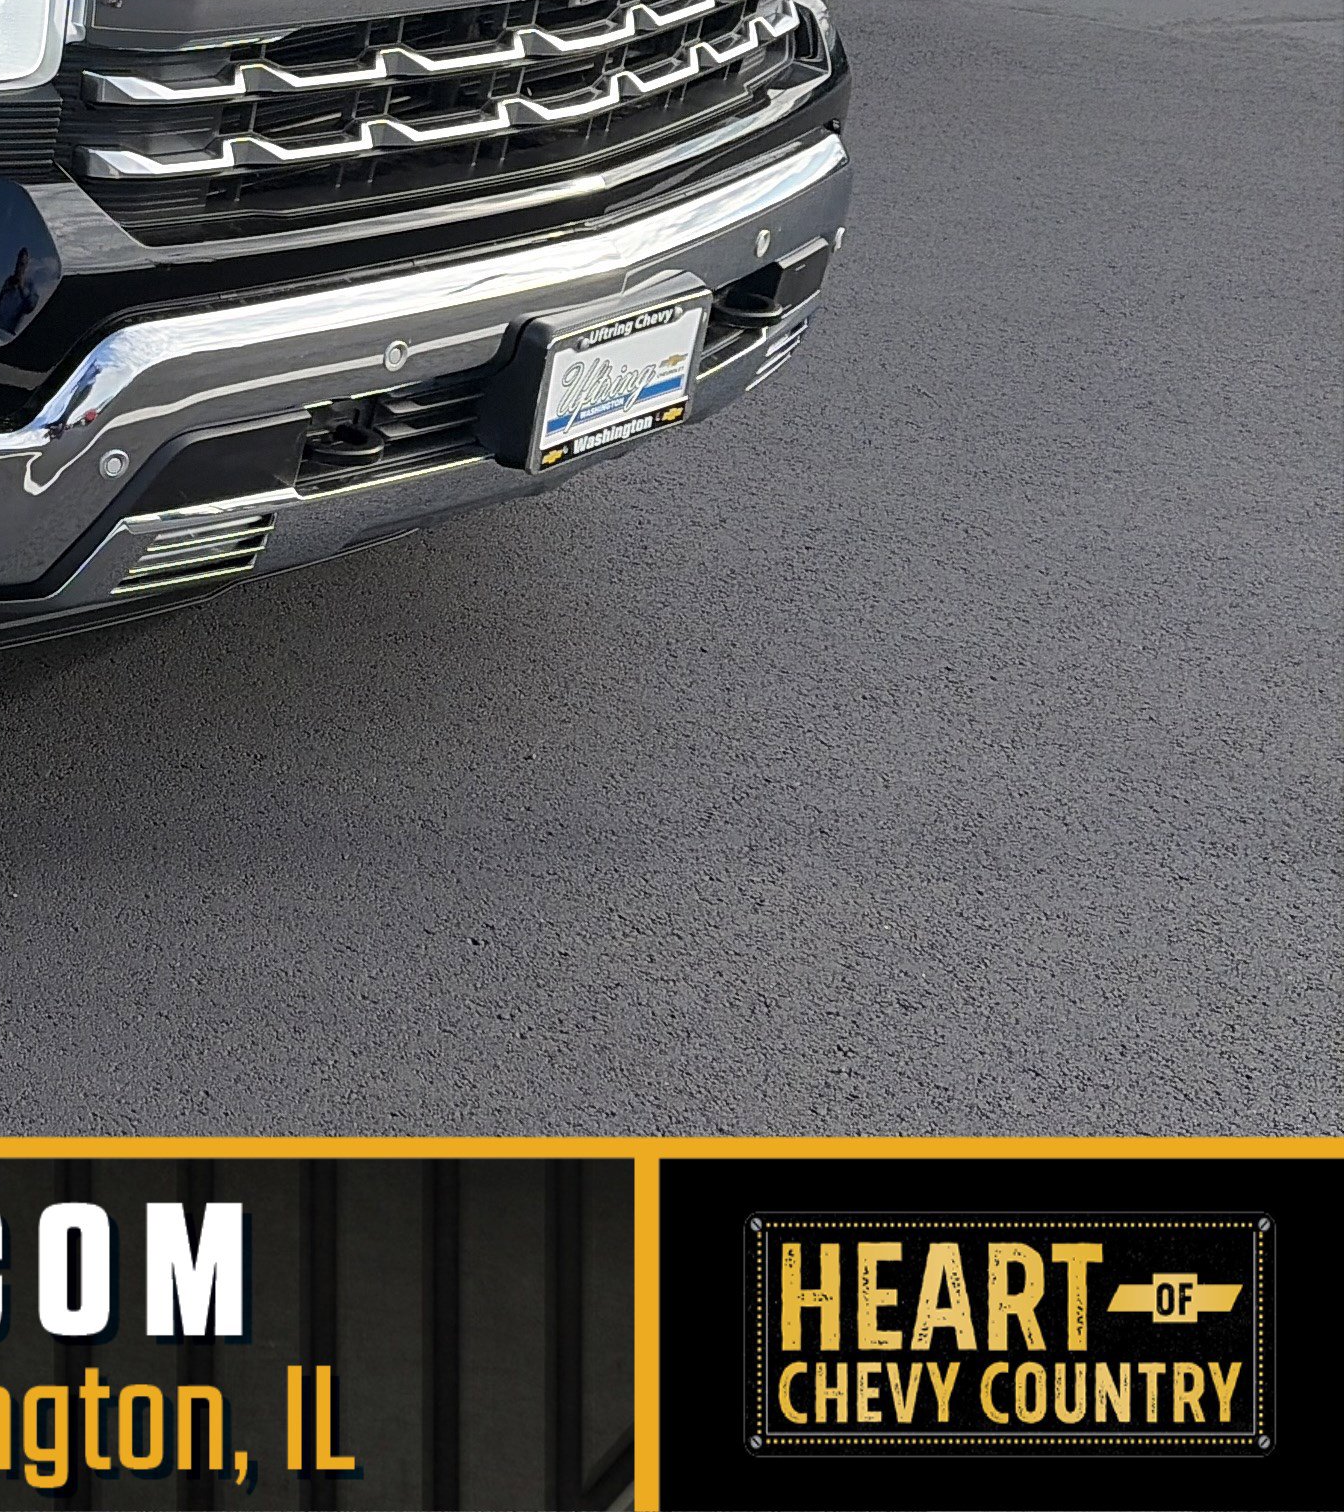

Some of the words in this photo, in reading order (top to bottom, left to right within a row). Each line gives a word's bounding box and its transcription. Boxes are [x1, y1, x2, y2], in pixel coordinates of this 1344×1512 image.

[588, 319, 633, 345] Uftring
[634, 307, 674, 329] Chevy
[556, 357, 656, 434] Uftring
[579, 398, 625, 420] WASHINGTON
[573, 415, 653, 454] Washington
